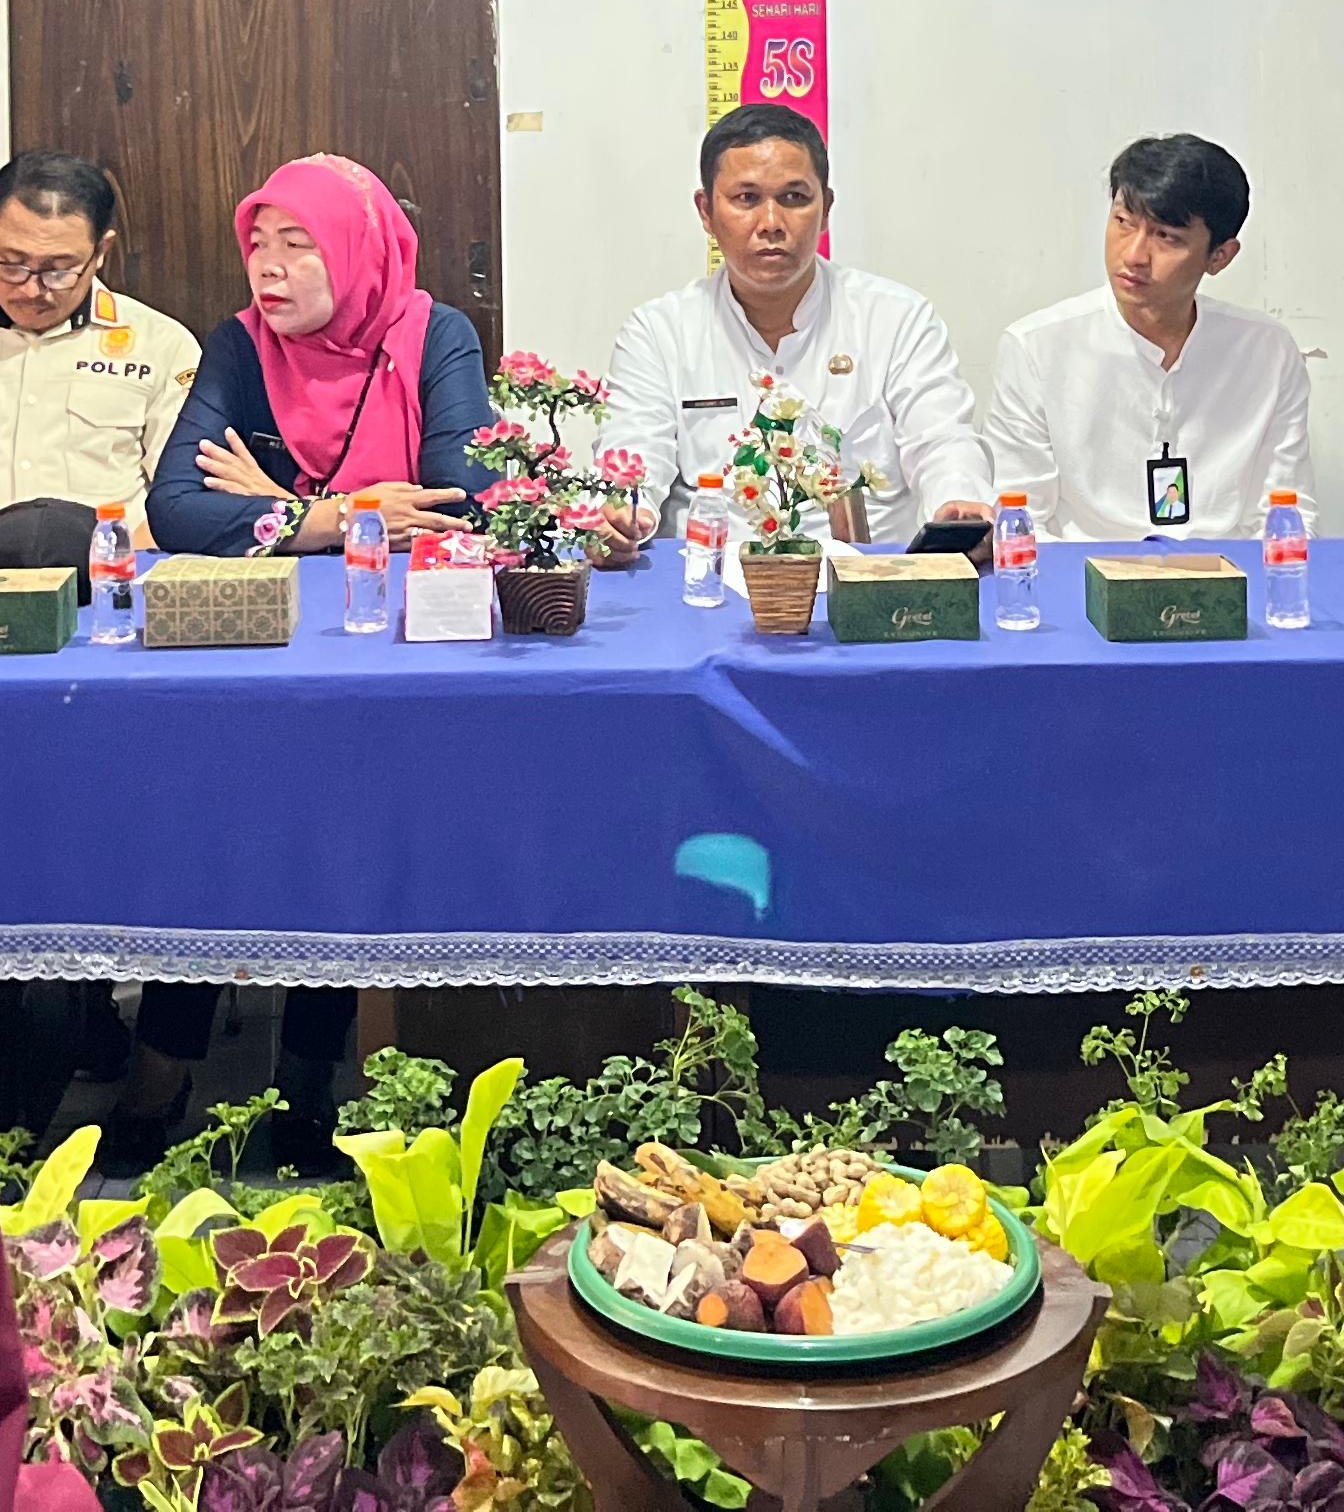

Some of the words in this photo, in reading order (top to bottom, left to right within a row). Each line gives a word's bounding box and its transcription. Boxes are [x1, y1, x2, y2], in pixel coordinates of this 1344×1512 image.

[760, 38, 814, 98] 5S
[76, 361, 119, 376] POL
[124, 362, 152, 380] PP
